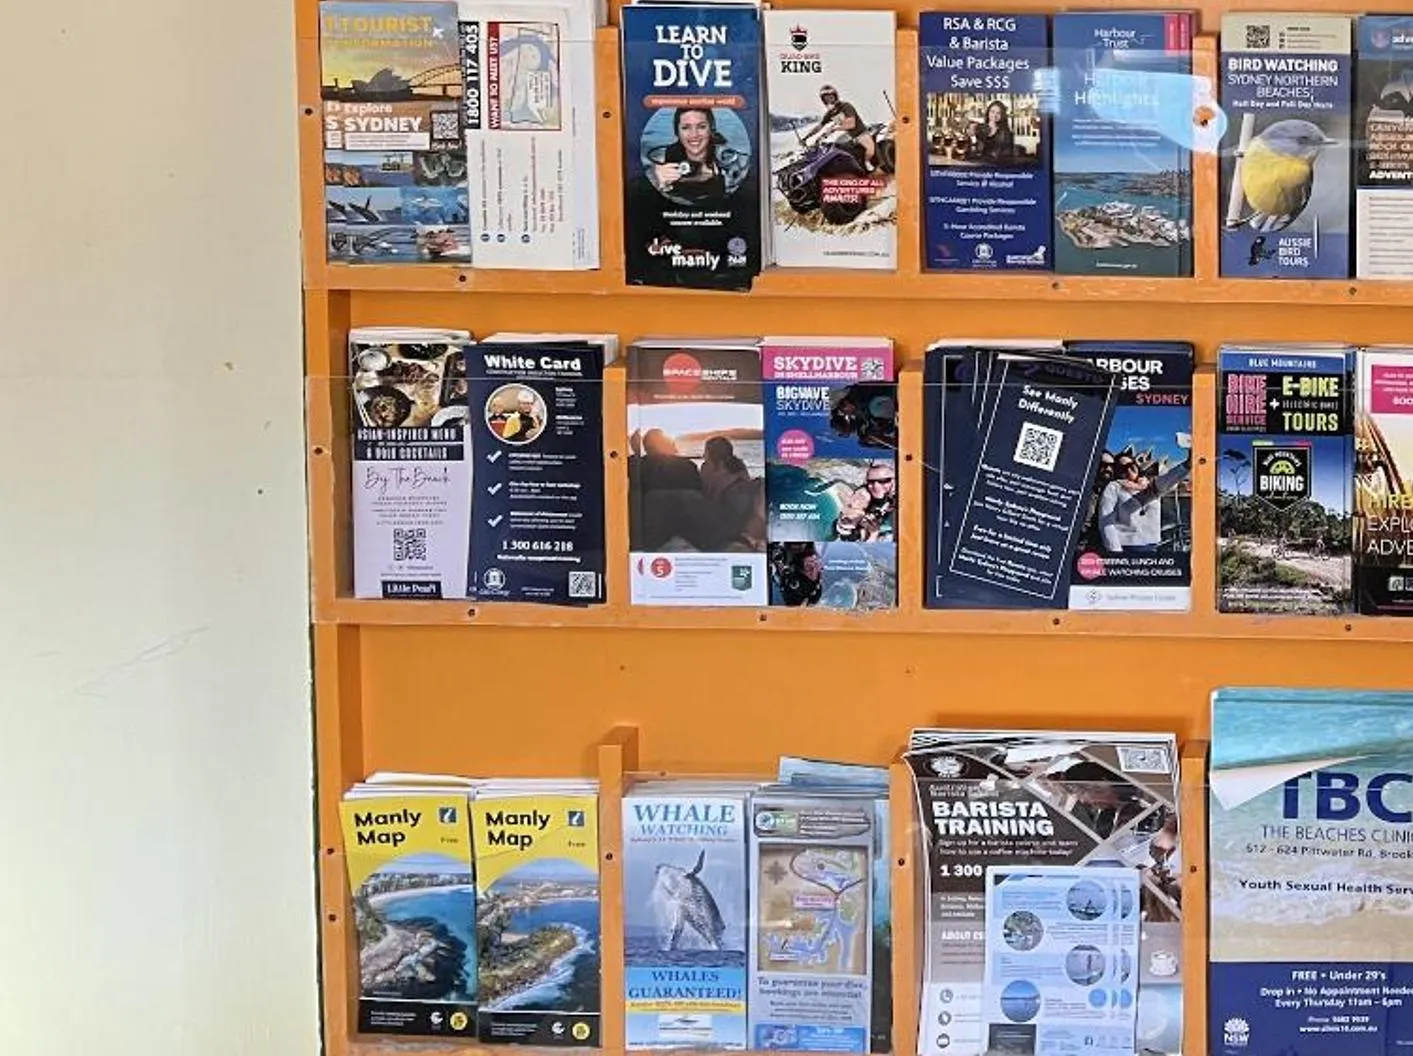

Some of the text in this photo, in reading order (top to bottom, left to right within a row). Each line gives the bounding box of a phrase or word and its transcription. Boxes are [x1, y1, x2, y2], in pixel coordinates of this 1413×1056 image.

[943, 18, 970, 31] RSA
[656, 25, 727, 44] LEARN
[680, 44, 703, 59] TO
[963, 38, 1009, 51] Barista
[781, 61, 822, 73] KING
[927, 55, 1030, 72] Value Packages
[1228, 59, 1338, 72] BIRD WATCHING
[467, 61, 479, 82] 117
[653, 60, 732, 87] DIVE
[951, 77, 982, 89] Save
[1228, 74, 1338, 86] SYDNEY NORTHERN
[467, 88, 479, 125] 1800
[345, 117, 421, 131] SYDNEY
[1279, 247, 1300, 256] BIRD
[485, 355, 581, 370] White Card
[774, 356, 857, 371] SKYDIVE
[1228, 375, 1267, 394] BIKE
[1282, 376, 1339, 397] E-BIKE
[1023, 385, 1078, 408] See Manly
[1136, 394, 1187, 405] SYDNEY
[777, 400, 830, 411] SKYDIVE
[1018, 399, 1075, 424] Differently
[1283, 412, 1338, 431] TOURS
[1260, 475, 1304, 491] BIKING
[634, 805, 735, 823] WHALE
[933, 802, 1047, 817] BARISTA
[354, 809, 421, 827] Manly
[486, 810, 550, 830] Manly
[641, 825, 727, 836] WATCHING
[935, 820, 1054, 836] TRAINING
[1262, 825, 1289, 839] THE
[1296, 825, 1366, 841] BEACHES
[357, 830, 405, 847] Map
[488, 831, 532, 851] Map
[954, 865, 982, 876] 300
[1240, 879, 1281, 890] Youth
[1286, 881, 1331, 891] Sexual
[1337, 883, 1382, 893] Health
[652, 971, 718, 982] WHALES
[1292, 970, 1362, 980] FREE Under
[629, 986, 741, 998] GUARANTEED!
